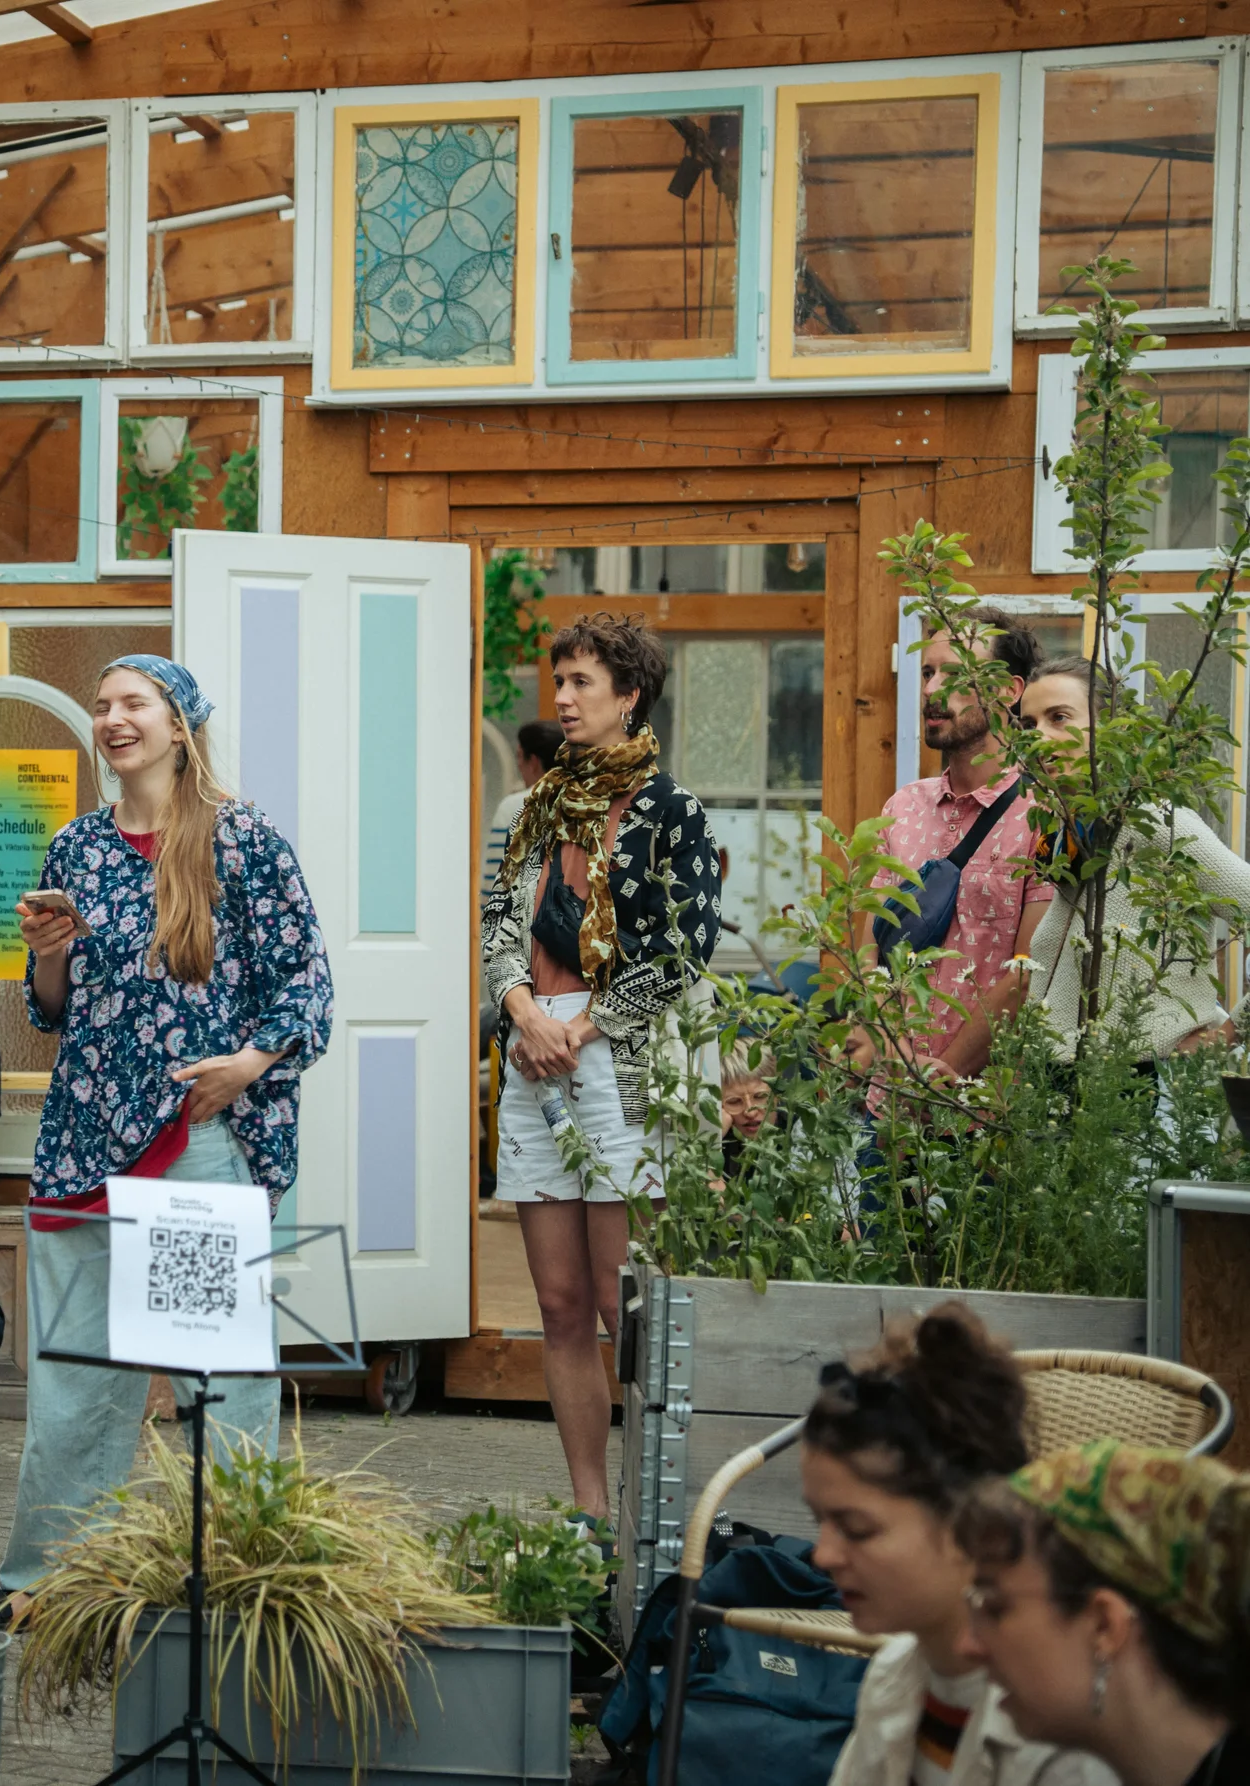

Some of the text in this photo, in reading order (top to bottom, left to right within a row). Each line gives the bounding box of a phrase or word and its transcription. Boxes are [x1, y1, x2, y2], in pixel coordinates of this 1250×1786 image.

[17, 764, 41, 773] HOTEL
[17, 774, 70, 783] CONTINENTAL
[185, 1217, 201, 1226] for
[764, 1661, 796, 1673] adidas
